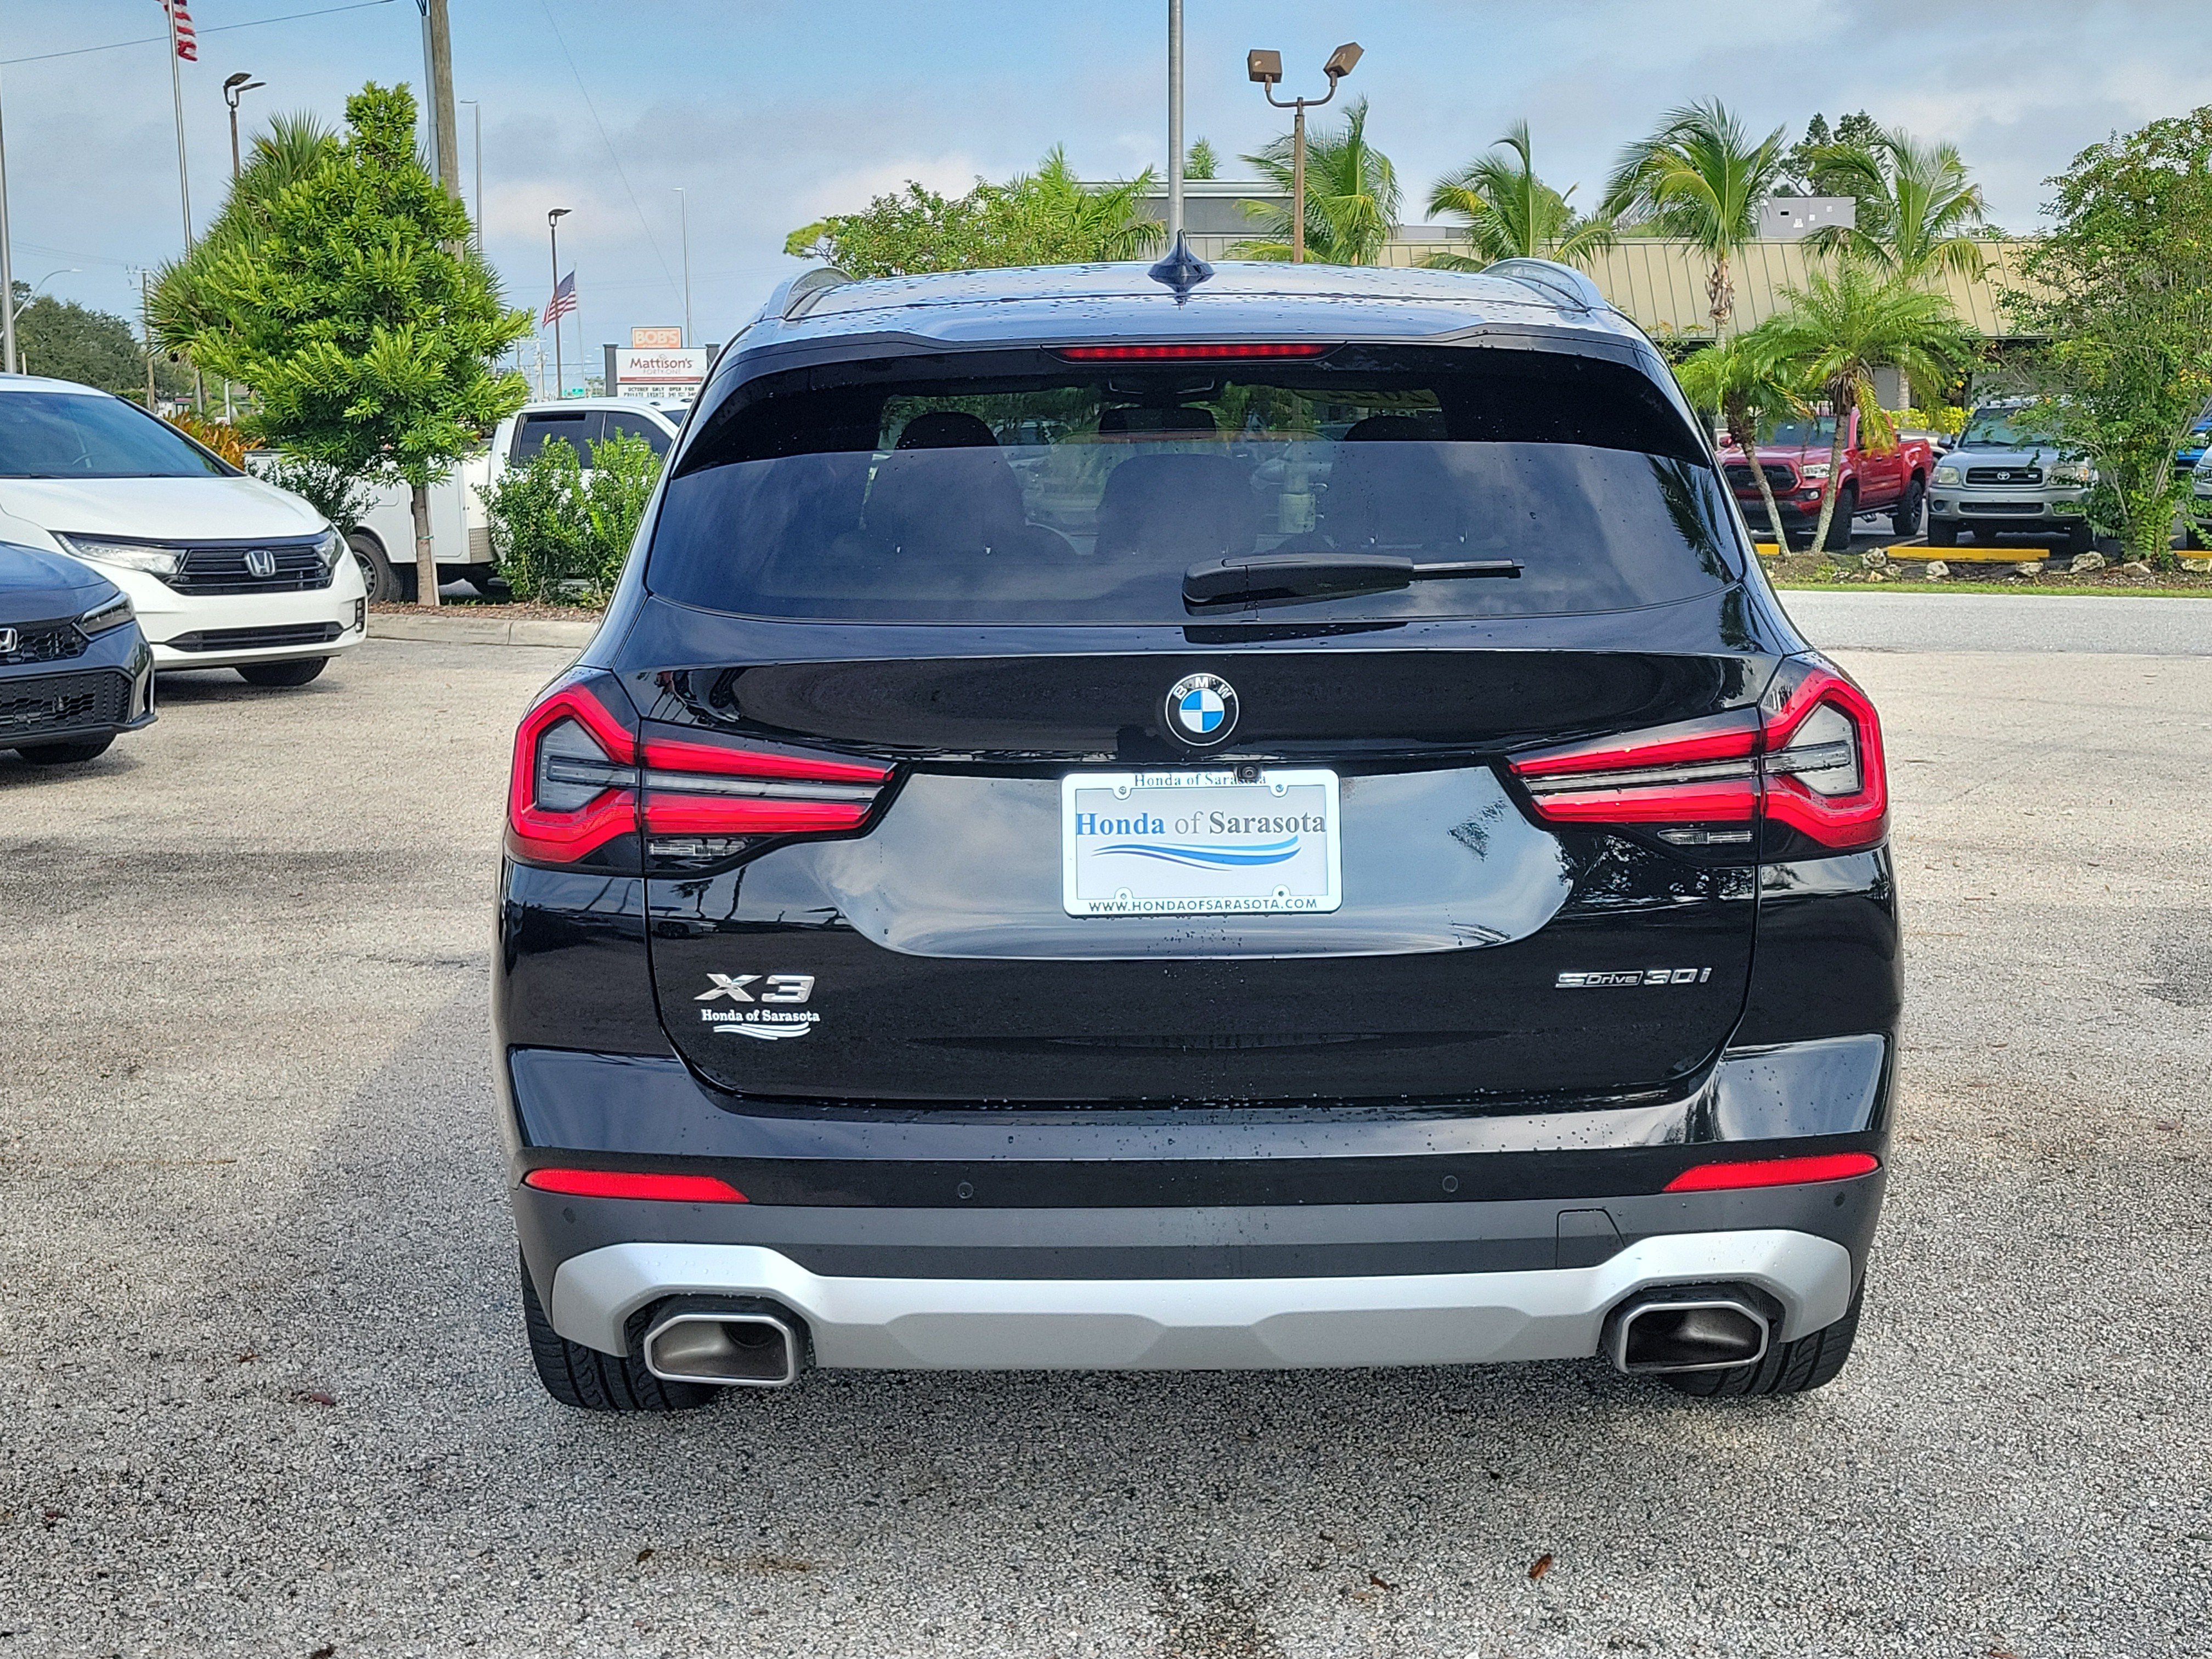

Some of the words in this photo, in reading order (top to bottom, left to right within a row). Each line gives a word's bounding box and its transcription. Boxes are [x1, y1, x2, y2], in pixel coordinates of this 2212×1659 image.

[635, 330, 678, 345] BOB'S
[630, 358, 692, 368] Mattison's
[1173, 676, 1233, 700] BMW
[1135, 774, 1181, 786] Honda
[1187, 773, 1201, 786] of
[1076, 812, 1165, 836] Honda
[1175, 811, 1203, 834] of
[1209, 811, 1327, 834] Sarasota
[1088, 899, 1317, 912] WWW.HONDAOFSARASOTA.COM
[693, 973, 815, 1003] X3
[701, 1009, 743, 1022] Honda
[746, 1009, 760, 1022] of
[763, 1009, 820, 1022] Sarasota
